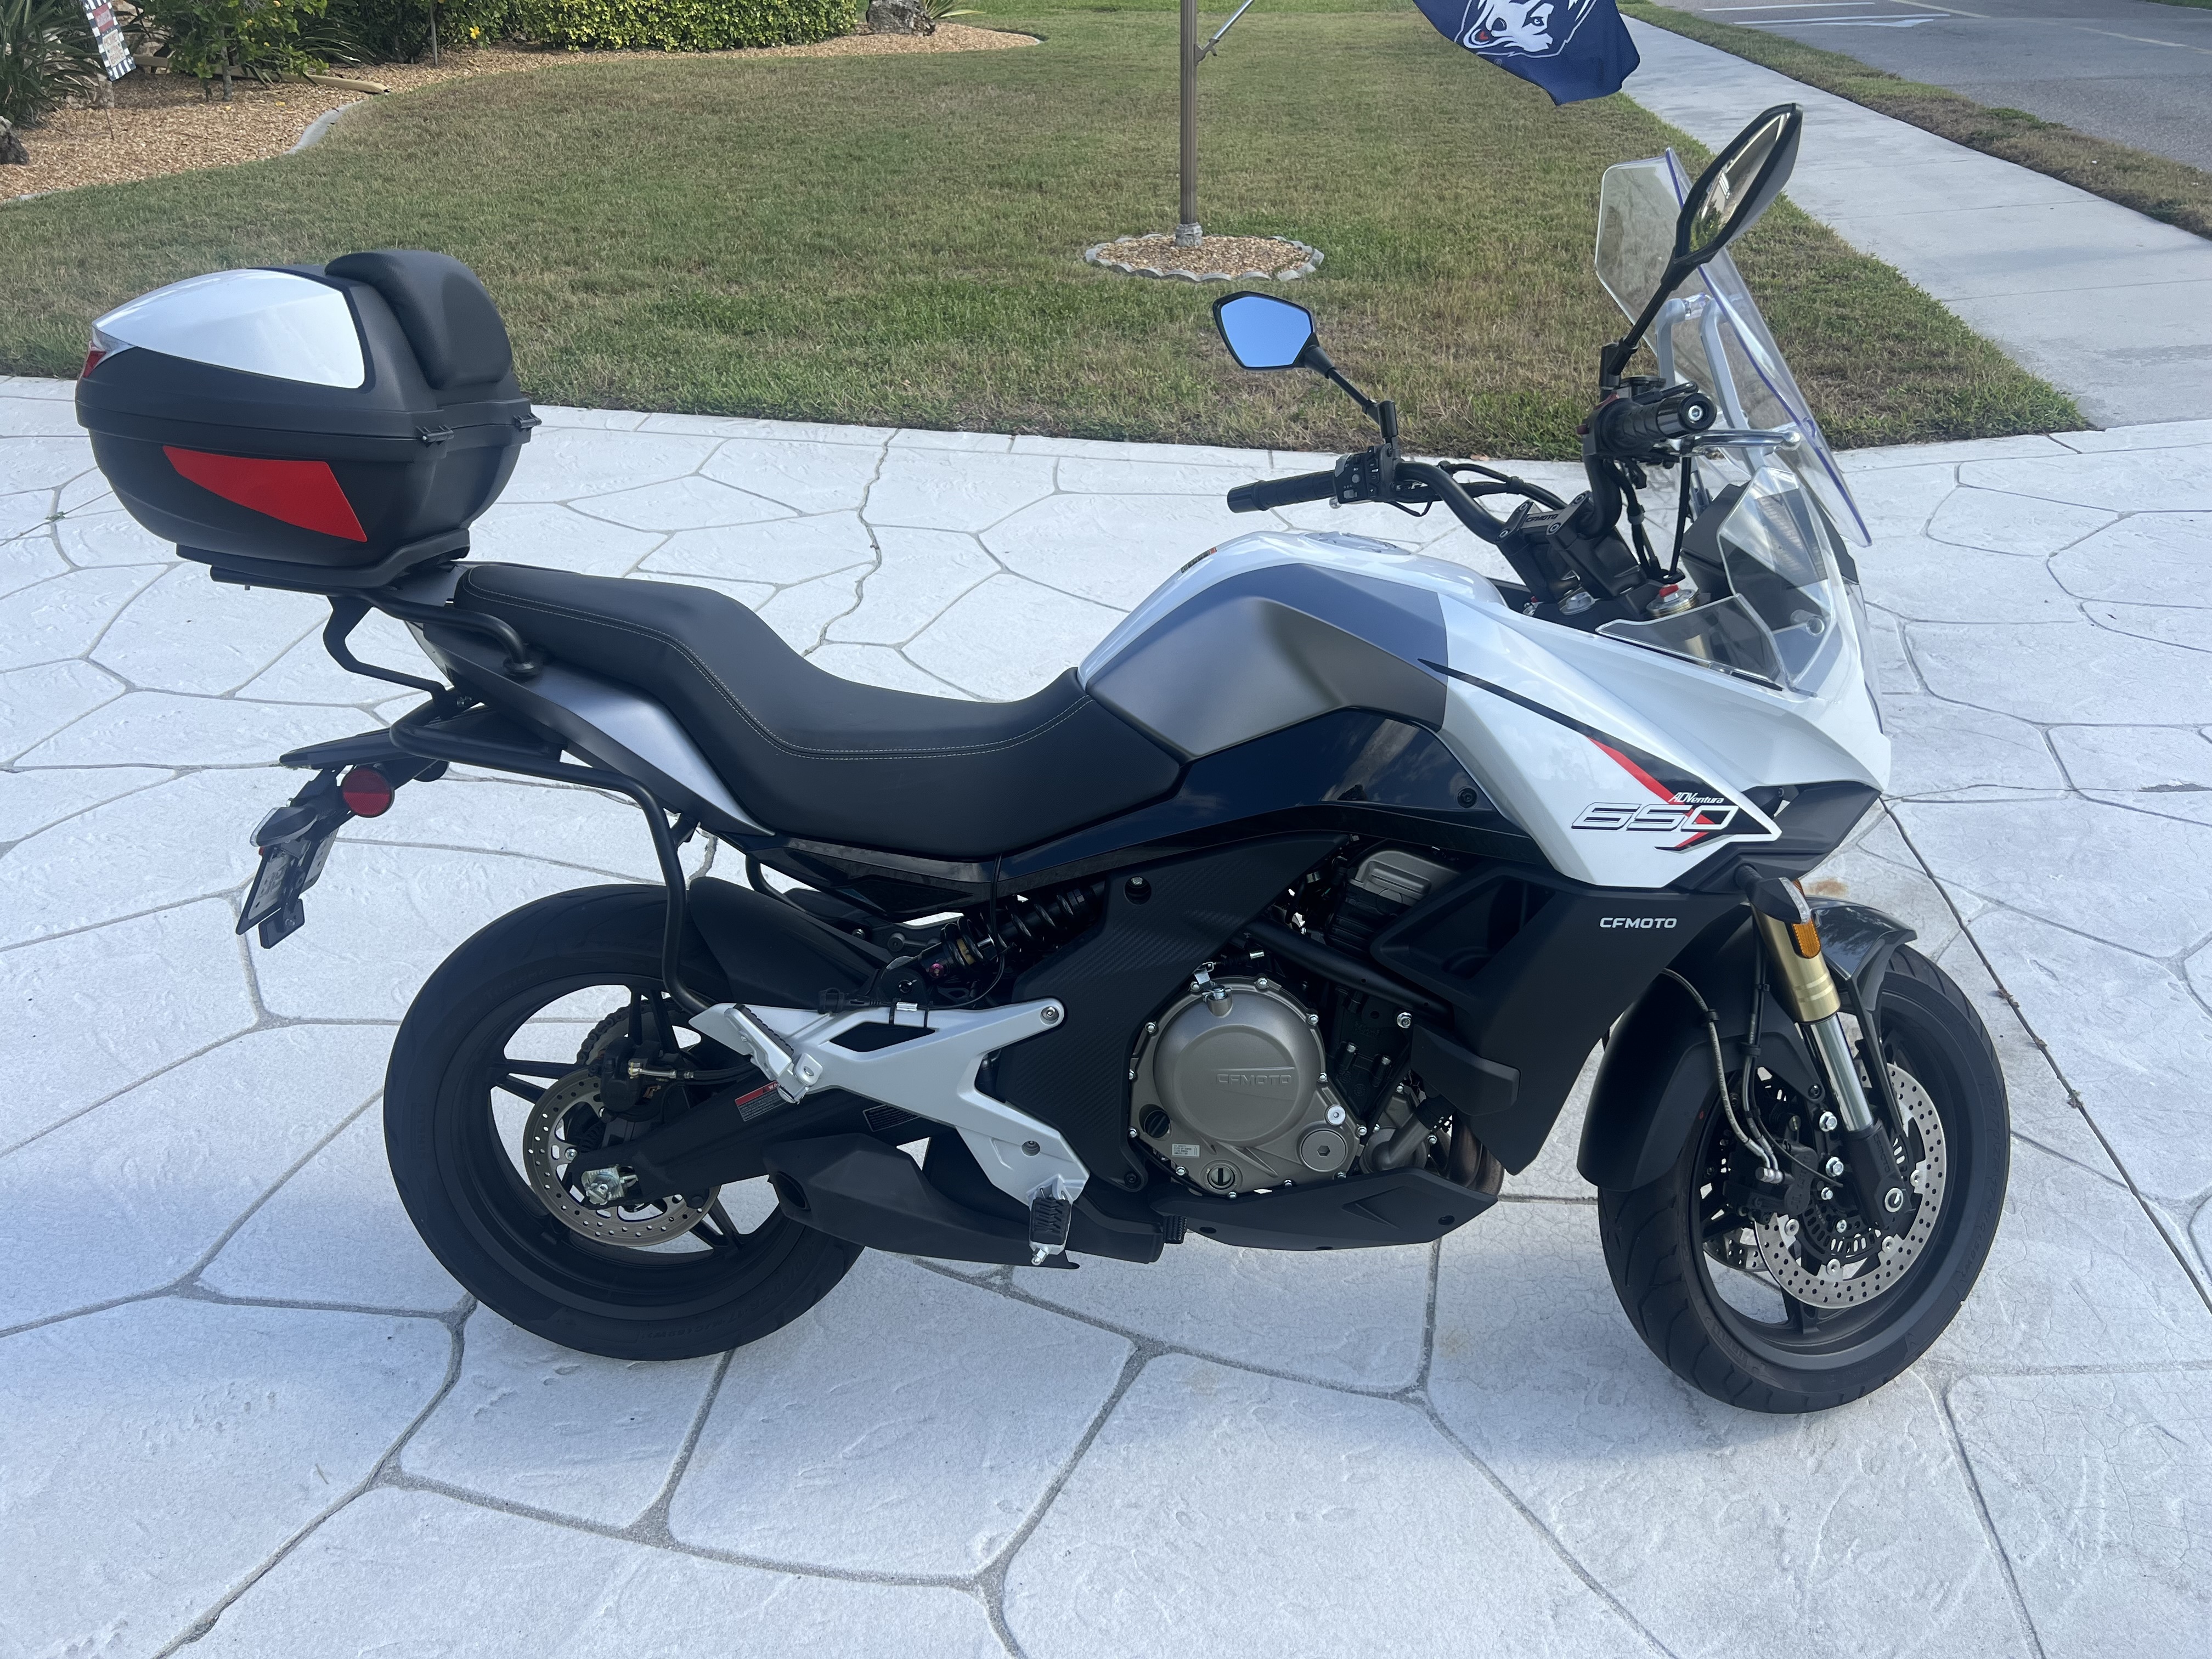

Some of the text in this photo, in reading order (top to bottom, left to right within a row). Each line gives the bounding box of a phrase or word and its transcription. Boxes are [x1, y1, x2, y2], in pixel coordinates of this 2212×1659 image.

[1668, 792, 1725, 804] ADVentura
[1571, 802, 1739, 832] 650
[1599, 917, 1677, 928] CFMOTO
[1216, 1074, 1292, 1086] CFMOTO
[1874, 1133, 1891, 1172] CFMOTO
